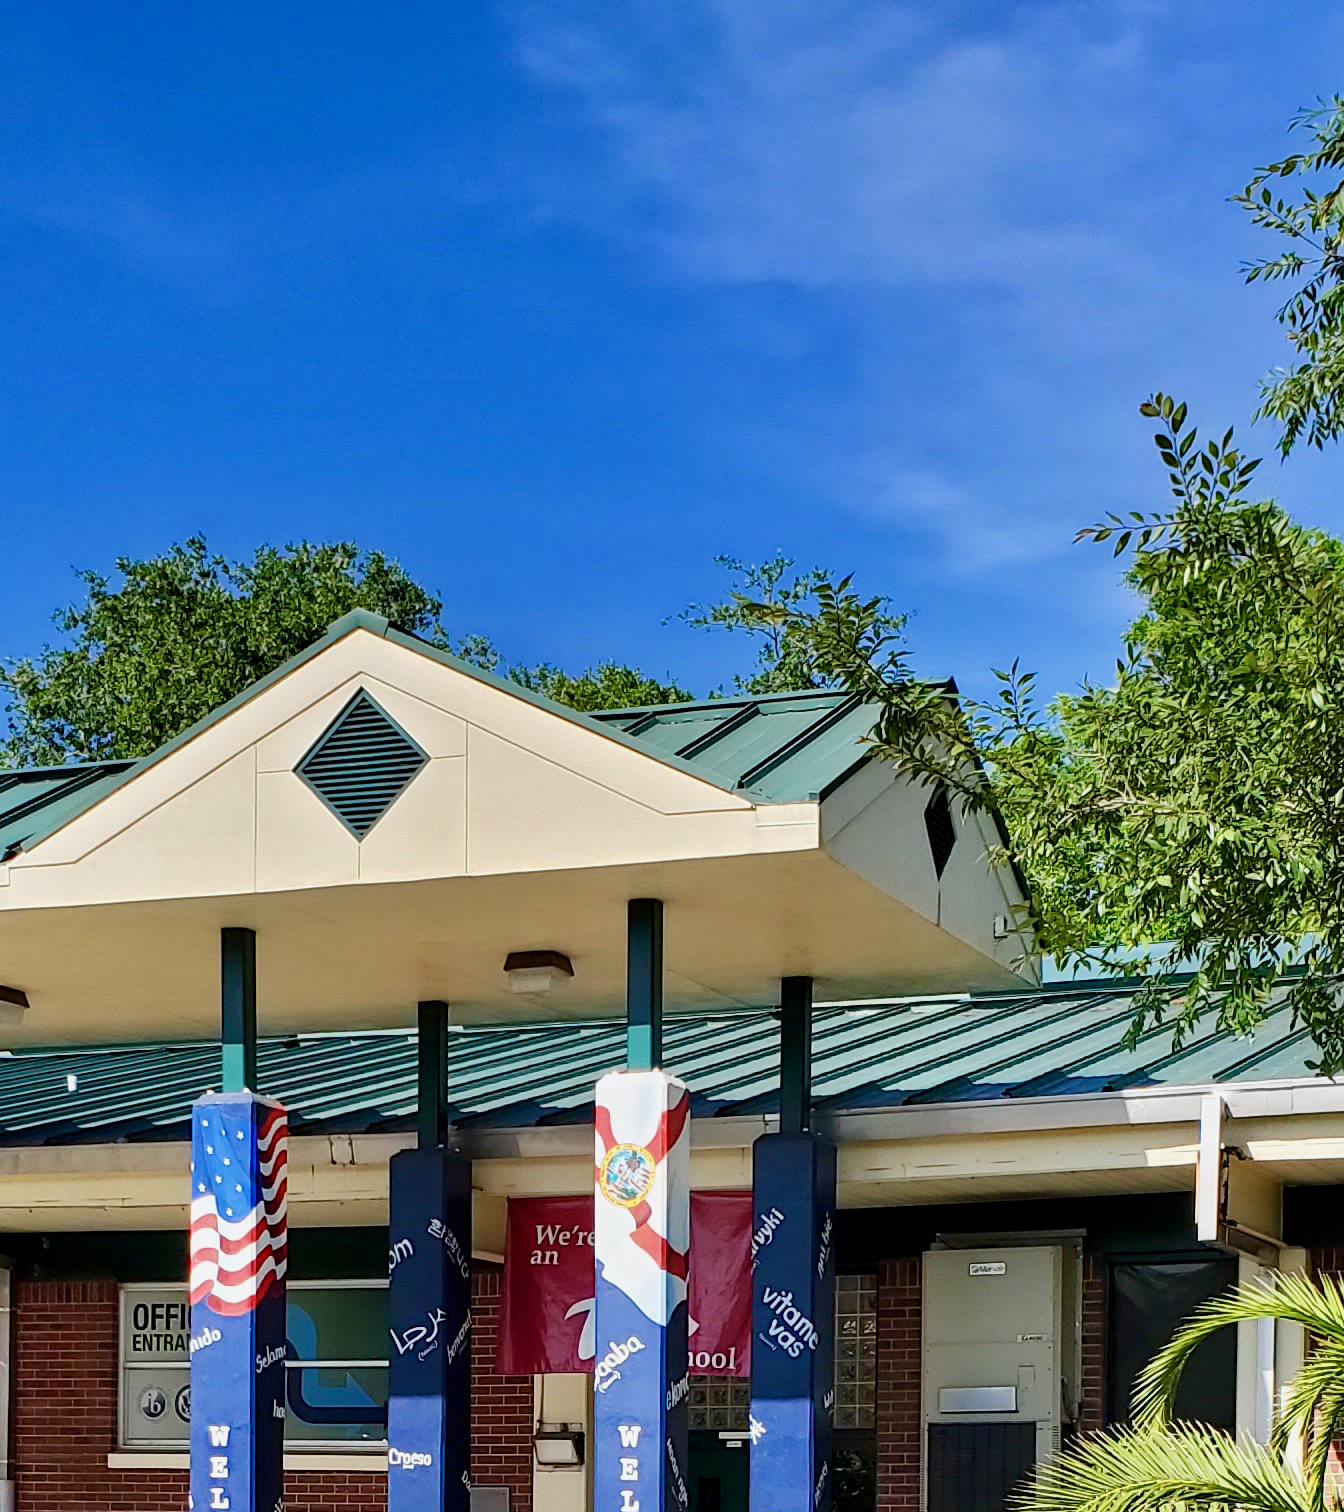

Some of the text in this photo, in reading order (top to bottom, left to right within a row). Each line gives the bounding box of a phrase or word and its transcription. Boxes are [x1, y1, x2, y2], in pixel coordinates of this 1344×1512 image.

[530, 1250, 560, 1265] an
[133, 1303, 191, 1331] OFFI
[762, 1287, 819, 1351] vitame
[769, 1318, 805, 1358] vas
[388, 1449, 432, 1465] Croeso
